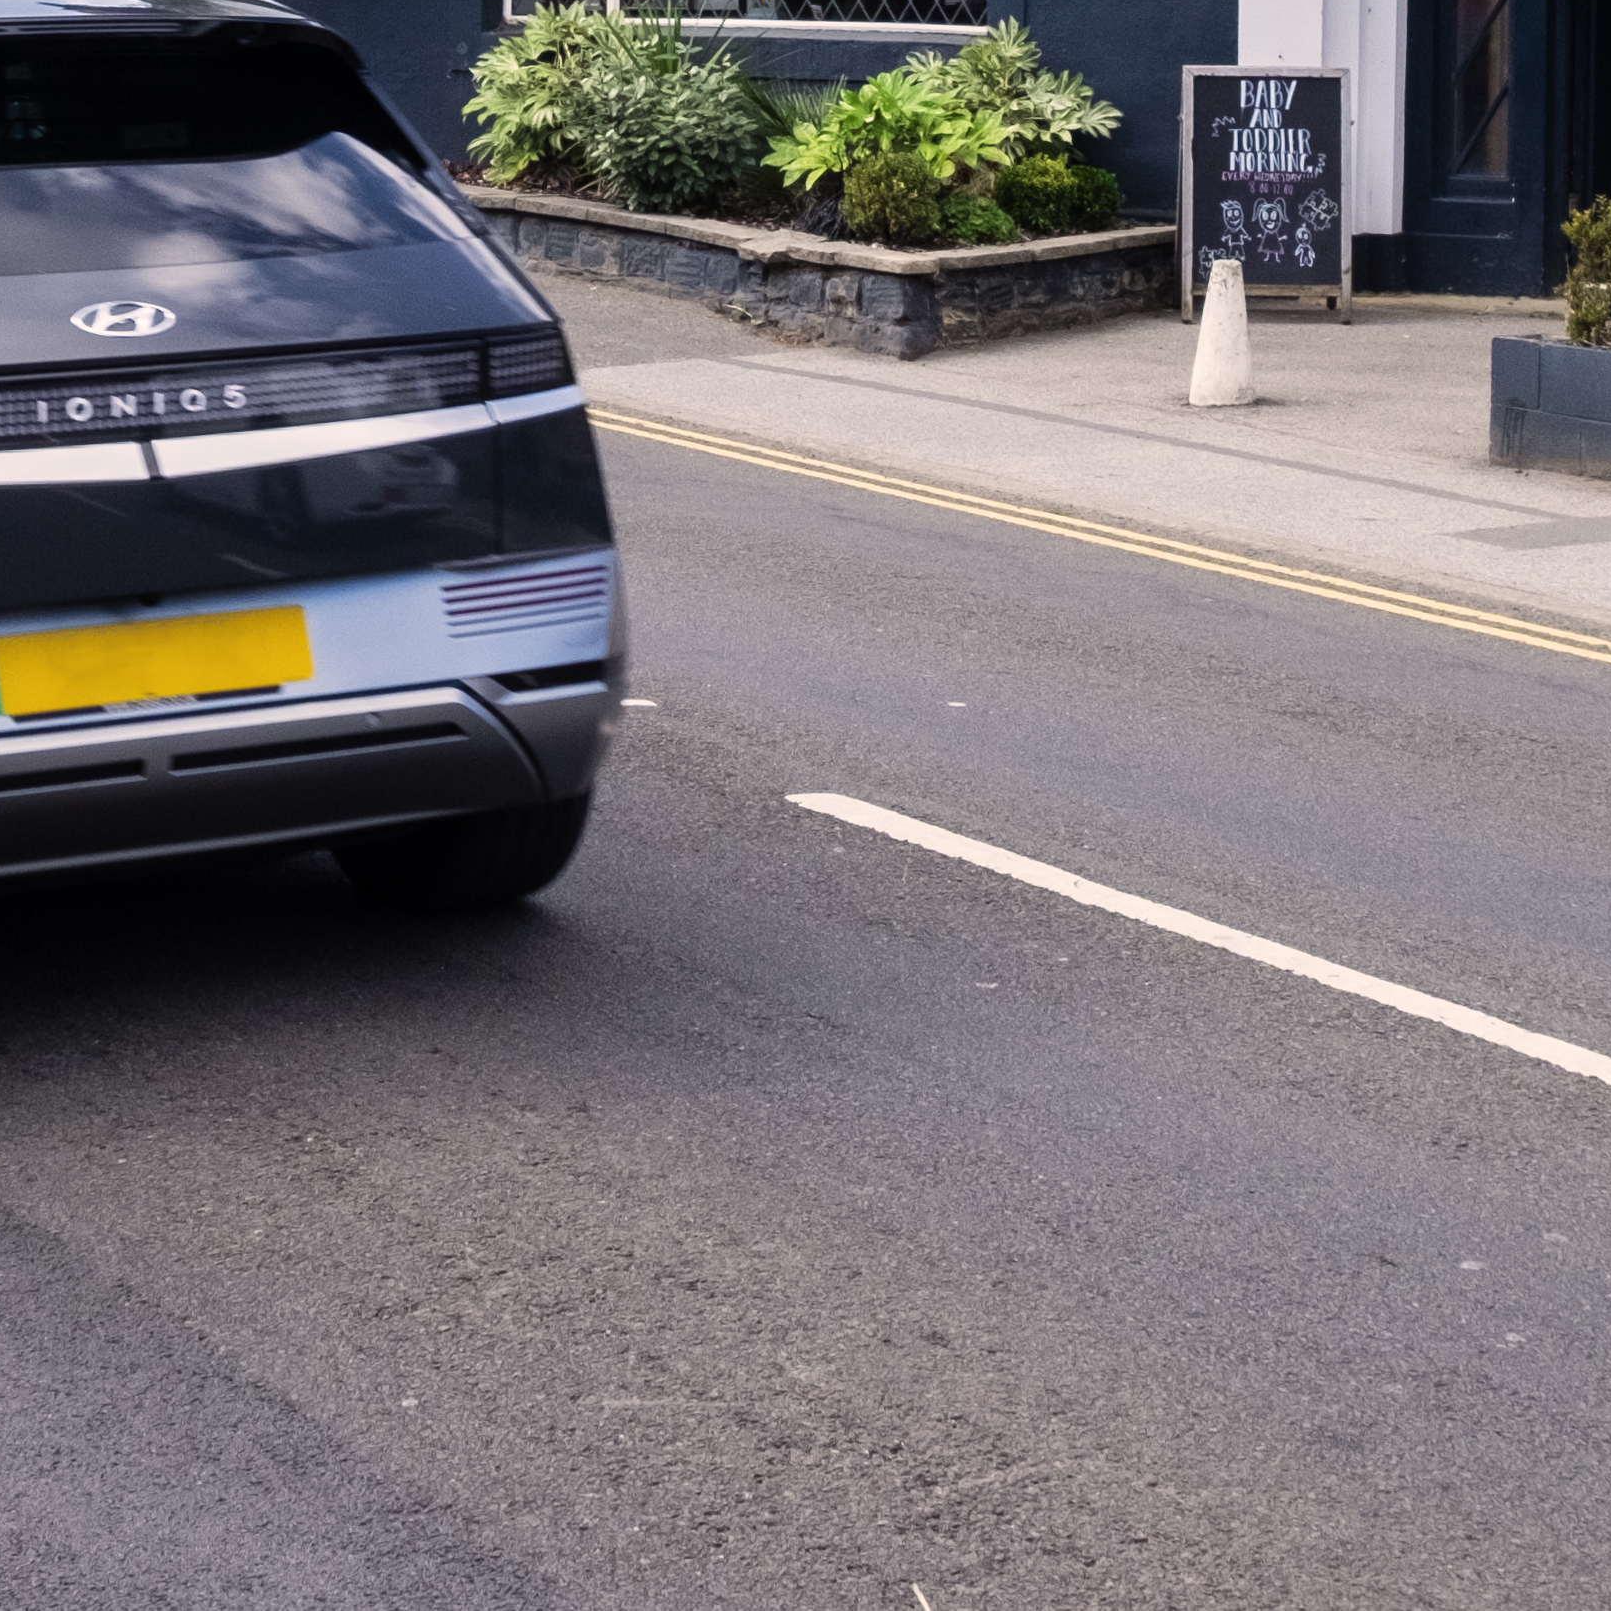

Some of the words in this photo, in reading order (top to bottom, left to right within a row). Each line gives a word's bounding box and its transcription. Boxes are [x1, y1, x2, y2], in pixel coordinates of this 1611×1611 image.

[1240, 79, 1297, 110] BABY
[1249, 108, 1282, 128] AND
[1228, 128, 1312, 155] TODDLER
[1229, 151, 1313, 173] MORNING
[1221, 171, 1251, 181] EVERY
